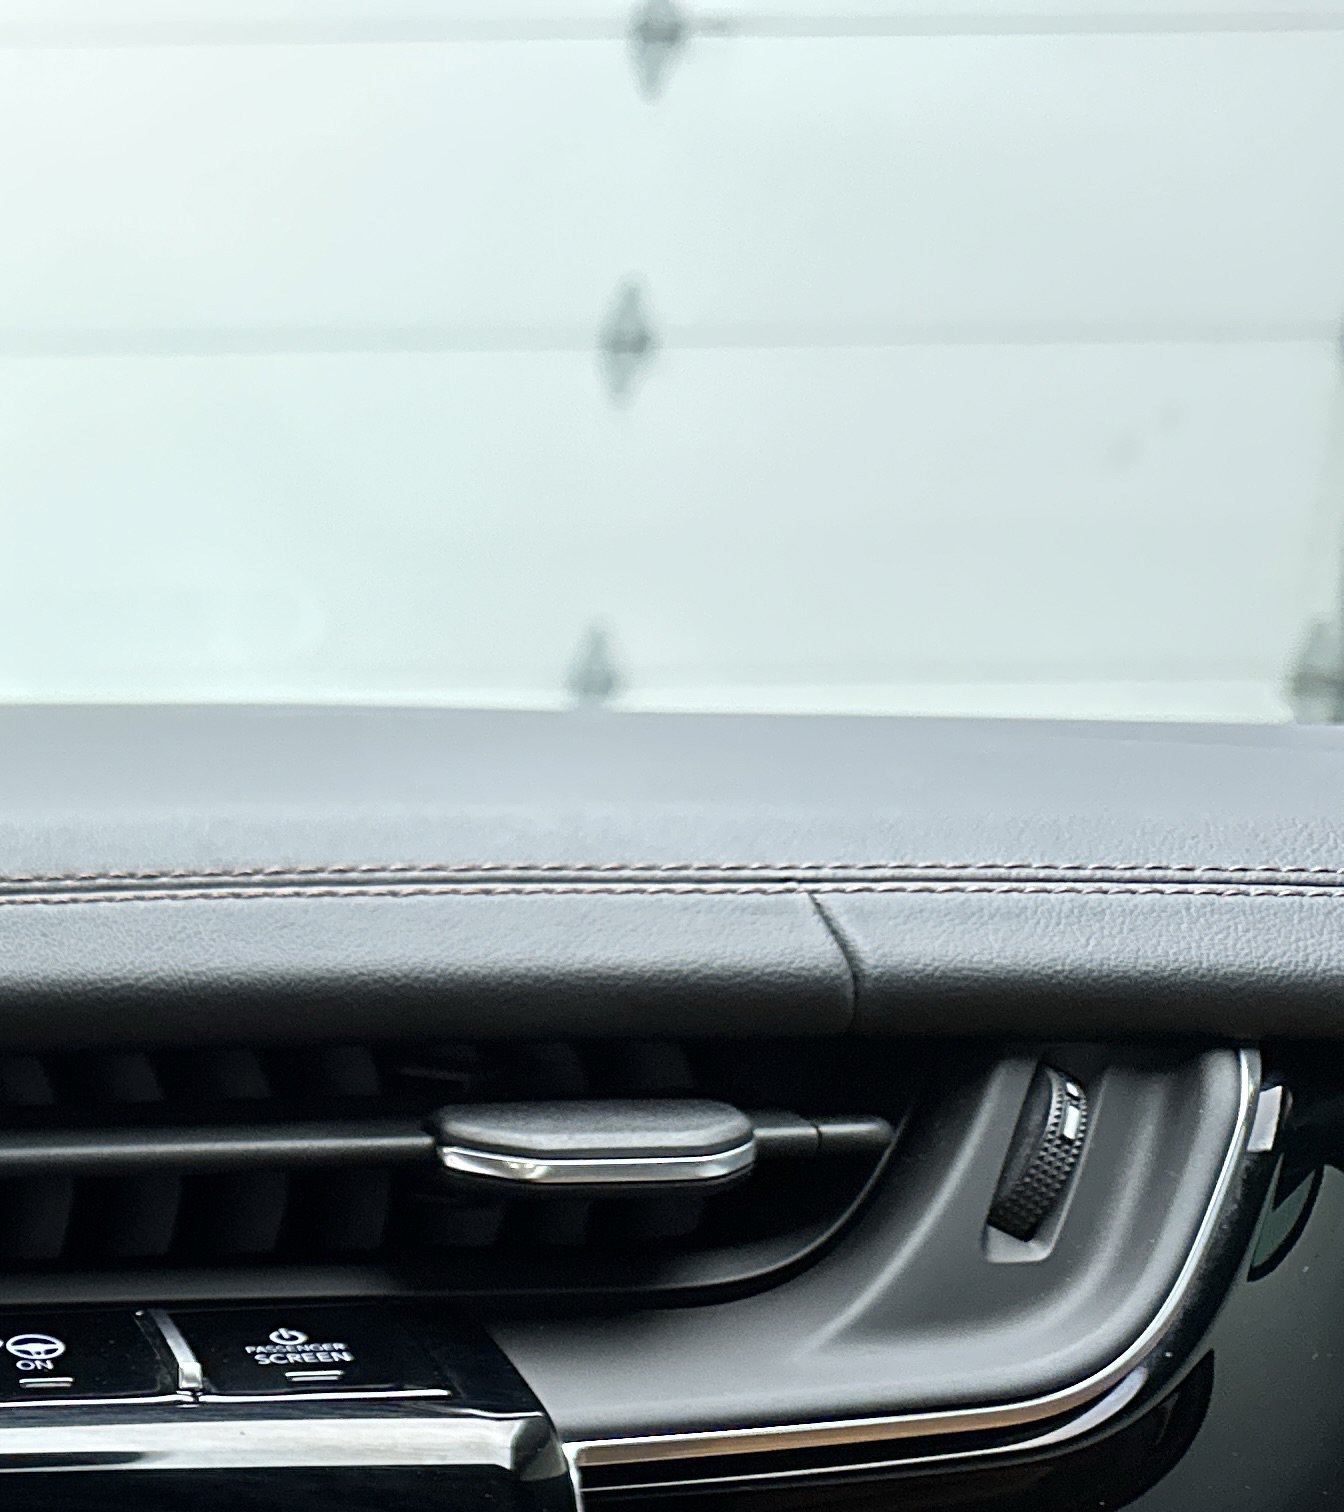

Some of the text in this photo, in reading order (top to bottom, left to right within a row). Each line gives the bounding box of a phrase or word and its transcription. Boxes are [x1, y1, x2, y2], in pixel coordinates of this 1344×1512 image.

[243, 1341, 349, 1354] PASSENGER
[15, 1357, 54, 1371] ON
[252, 1351, 356, 1366] SCREEN
